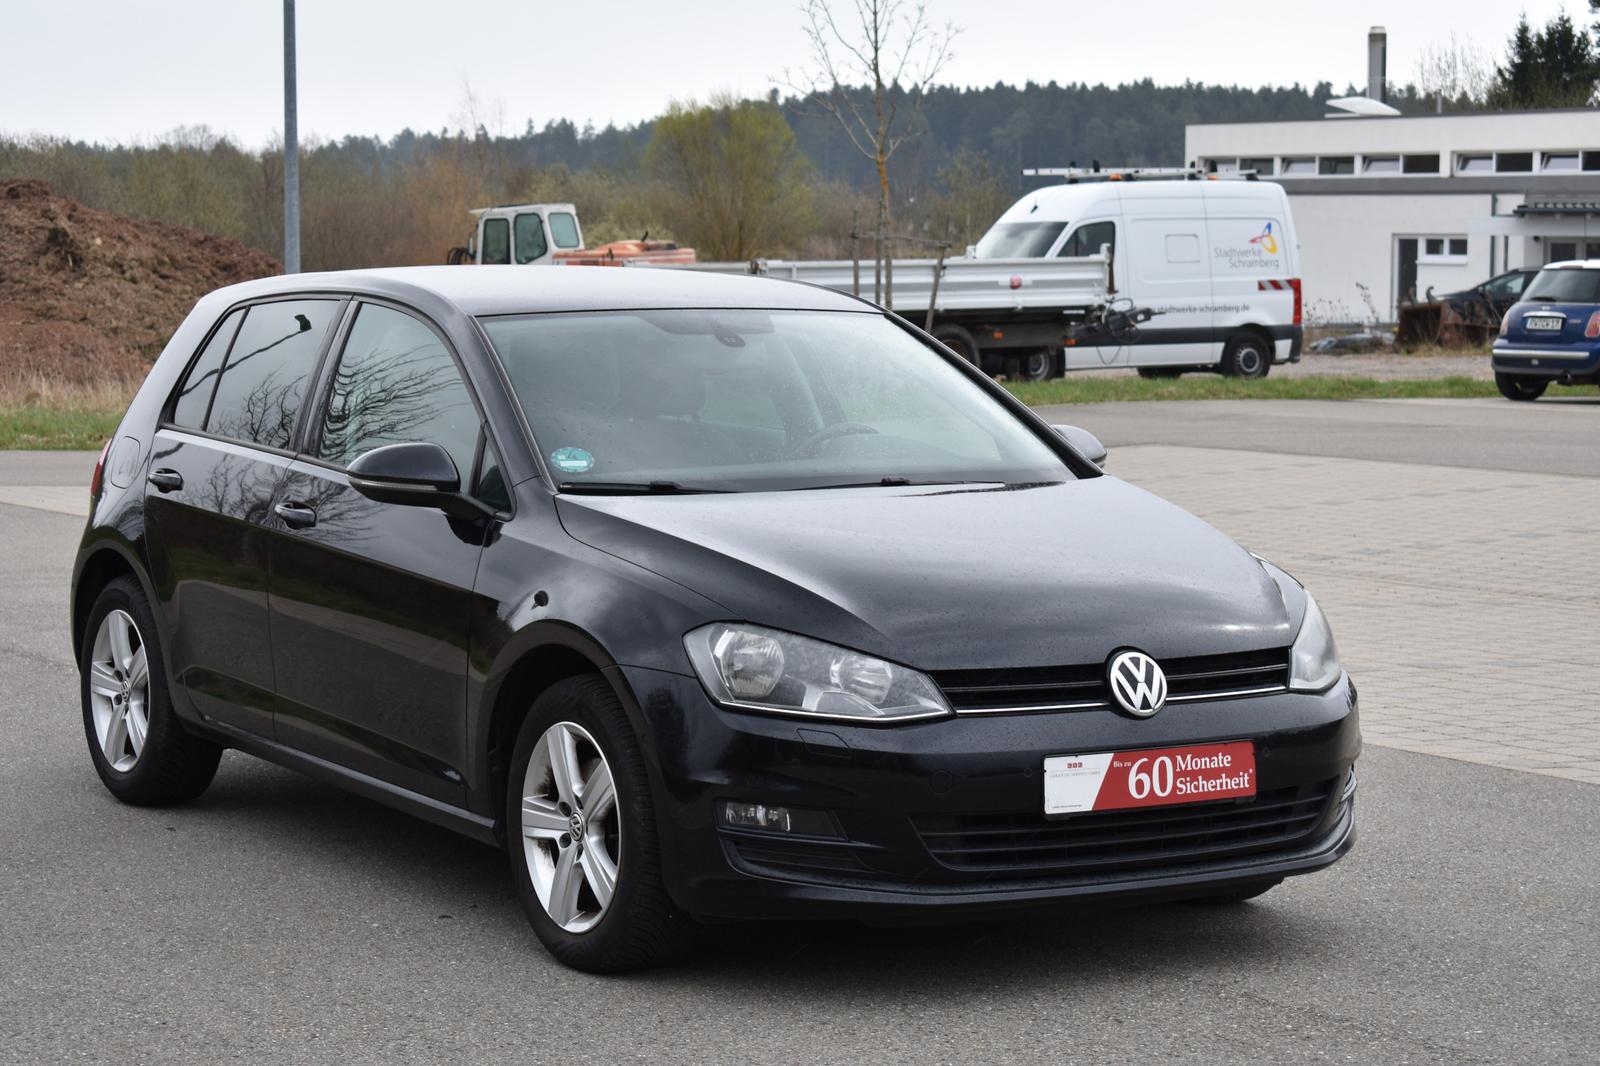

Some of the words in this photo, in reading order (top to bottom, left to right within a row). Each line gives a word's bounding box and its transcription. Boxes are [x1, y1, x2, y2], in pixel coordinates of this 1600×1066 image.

[1213, 247, 1262, 258] Stadtwerke
[1228, 258, 1280, 270] Schramberg
[1136, 303, 1250, 316] stadtwerke-schramberg.de
[1175, 753, 1232, 772] Monate
[1128, 756, 1174, 799] 60
